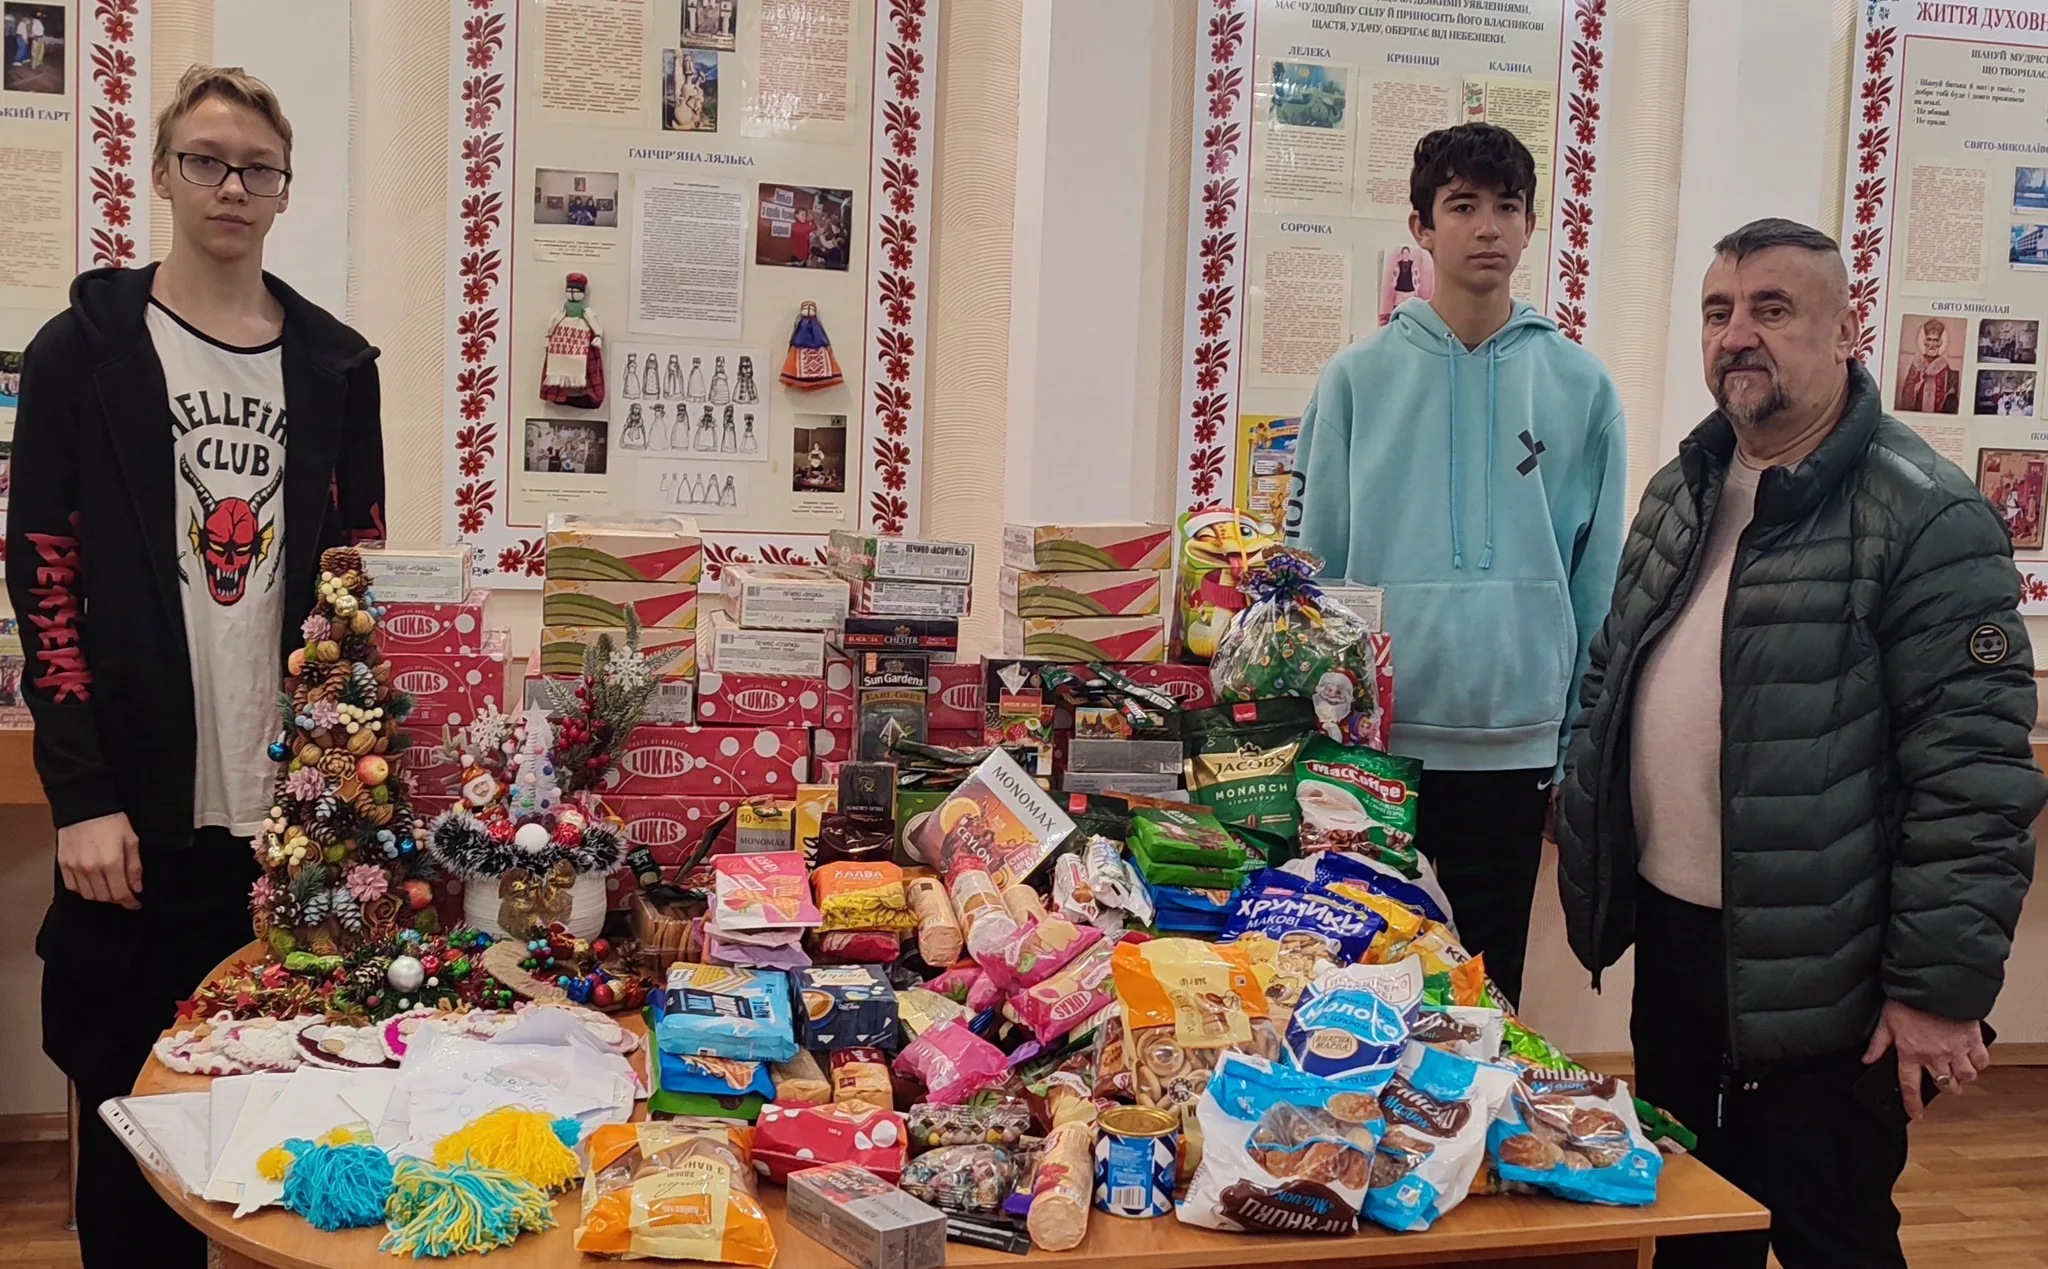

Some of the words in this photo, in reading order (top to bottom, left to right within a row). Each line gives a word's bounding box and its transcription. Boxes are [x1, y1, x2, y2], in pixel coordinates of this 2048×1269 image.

[1358, 6, 1385, 17] СИЛУ
[1396, 10, 1455, 24] ПРИНОСИТЬ
[1457, 13, 1482, 26] ЙОГО
[1484, 17, 1544, 31] ВЛАСНИКОВІ
[1916, 2, 1978, 26] ЖИТТЯ
[1431, 29, 1447, 40] ВІД
[1288, 45, 1332, 58] ЛЕЛЕКА
[1386, 52, 1440, 67] КРИНИЦЯ
[1971, 49, 2007, 61] ШАНУЙ
[1488, 60, 1533, 75] КАЛИНА
[1982, 65, 1998, 76] ЩО
[39, 109, 72, 122] ГАРТ
[628, 147, 702, 164] ГАНЧІР'ЯНА
[704, 151, 755, 167] ЛЯЛЬКА
[1280, 220, 1333, 235] СОРОЧКА
[1931, 301, 1962, 312] СВЯТО
[1964, 303, 2010, 314] МИКОЛАЯ
[196, 437, 270, 477] CLUB
[394, 617, 433, 635] LUKAS
[884, 635, 919, 646] CHESTER
[401, 674, 441, 694] LUKAS
[864, 675, 883, 686] Sun
[884, 674, 923, 687] Gardens
[741, 693, 779, 709] LUKAS
[632, 749, 684, 775] LUKAS
[1215, 753, 1286, 777] JACOBS
[1312, 763, 1401, 799] MacCoffee
[992, 766, 1056, 831] MONOMAX
[1215, 783, 1287, 801] MONARCH
[631, 821, 678, 843] LUKAS
[740, 837, 786, 847] MONOMAX
[957, 826, 994, 865] CEYLON
[834, 869, 884, 879] ХАЛВА
[1236, 898, 1364, 935] ХРУМИКИ
[1246, 914, 1299, 930] МАКОВІ
[1058, 992, 1088, 1018] LUKAS
